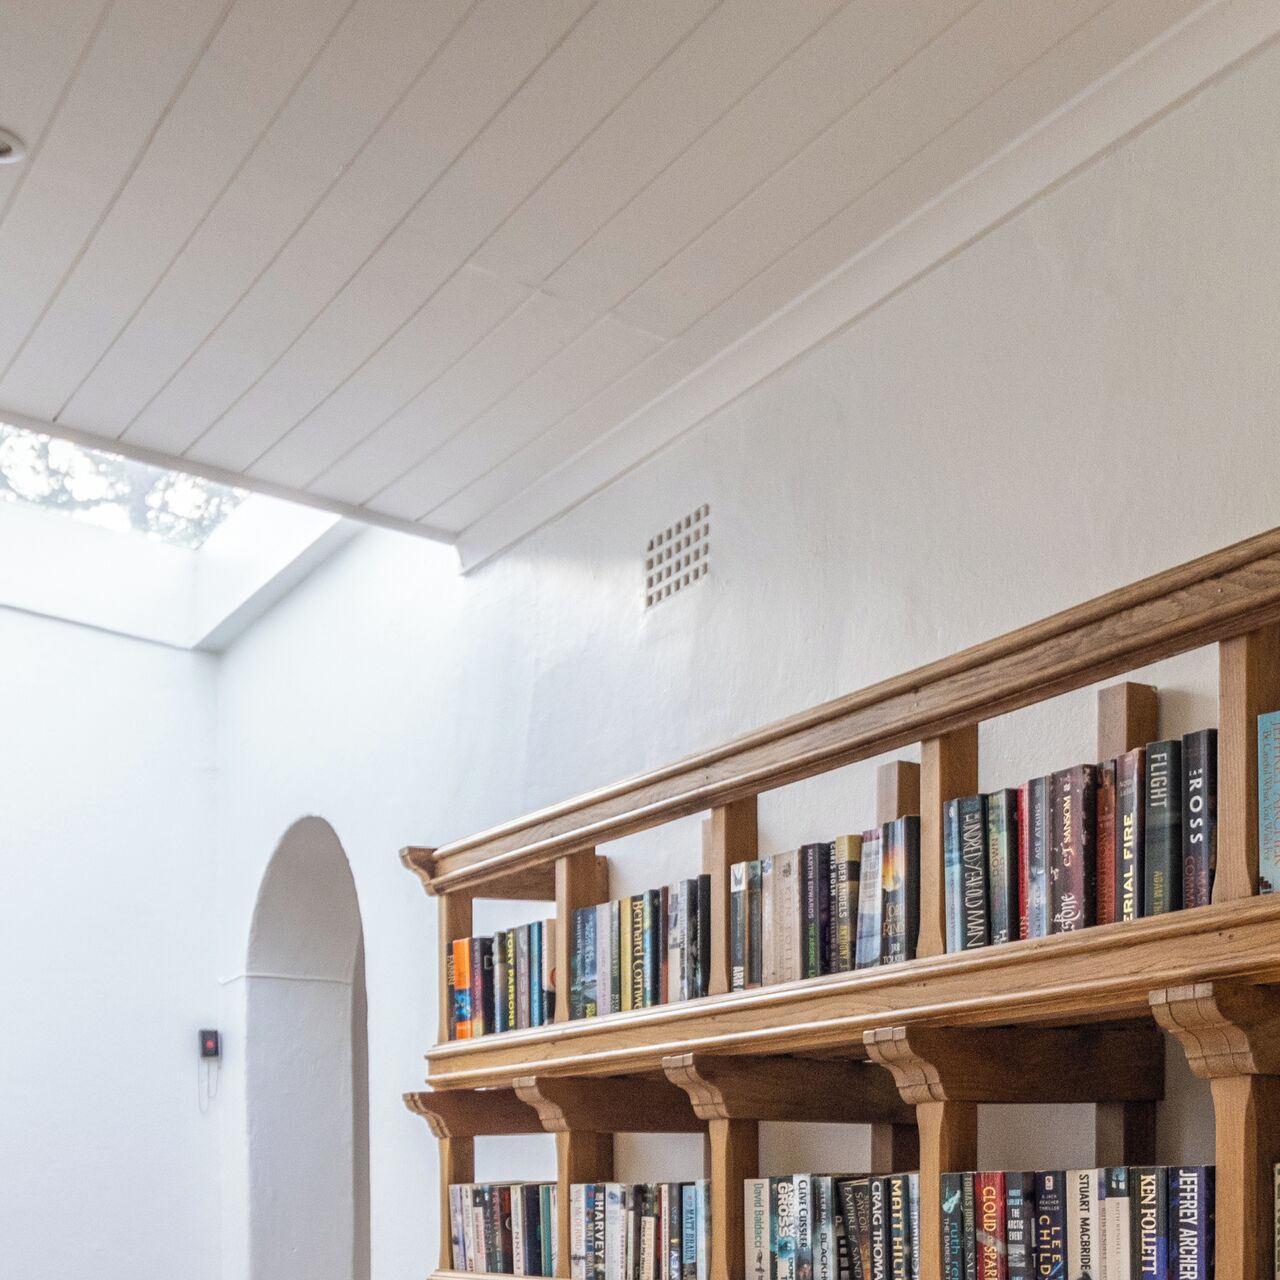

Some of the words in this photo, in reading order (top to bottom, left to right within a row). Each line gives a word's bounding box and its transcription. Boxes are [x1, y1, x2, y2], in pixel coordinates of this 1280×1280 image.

[1150, 752, 1167, 808] FLIGHT
[1064, 795, 1072, 842] SANSOM
[1189, 776, 1203, 843] ROSS
[1124, 814, 1133, 858] FIRE
[632, 900, 644, 953] Bernard
[967, 914, 984, 947] MAN
[778, 1182, 787, 1237] GROSS
[798, 1180, 807, 1206] CLIVE
[871, 1182, 883, 1225] CRAIG
[891, 1180, 902, 1231] MATT
[983, 1186, 996, 1232] CLOUD
[1079, 1174, 1089, 1213] STUART
[1140, 1175, 1156, 1204] KEN
[1179, 1170, 1197, 1224] JEFFREY
[1040, 1215, 1051, 1275] CHILD
[1051, 1227, 1061, 1262] LEE
[1140, 1208, 1156, 1275] FOLLETT
[1179, 1229, 1197, 1280] ARCHER
